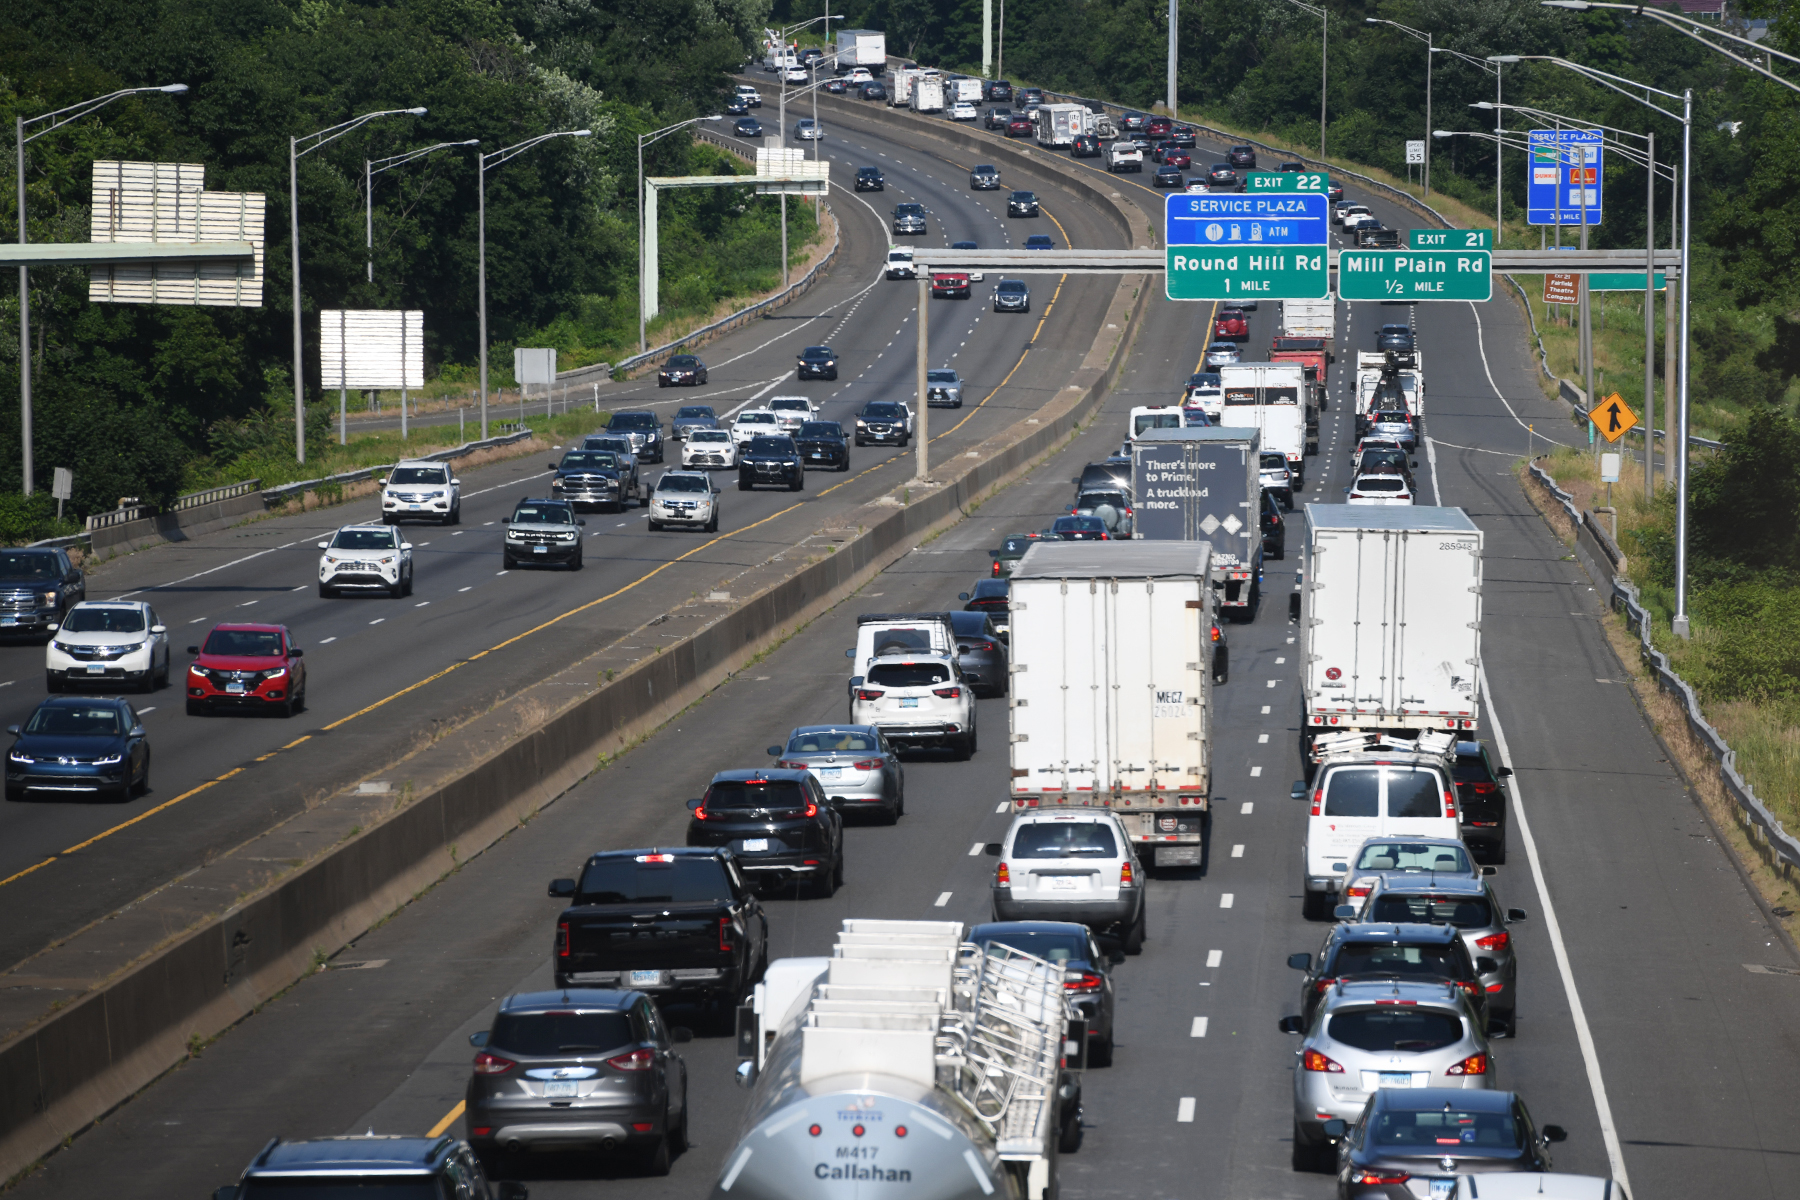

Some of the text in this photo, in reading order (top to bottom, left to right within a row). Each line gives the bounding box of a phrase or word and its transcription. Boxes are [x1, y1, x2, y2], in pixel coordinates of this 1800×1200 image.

[1254, 175, 1322, 190] EXIT 22
[1190, 200, 1307, 212] SERVICE PLAZA
[1269, 226, 1289, 237] ATM
[1417, 232, 1485, 247] EXIT 21
[1174, 255, 1322, 271] Round Hill Rd
[1348, 257, 1483, 272] Mill Plain Rd
[1224, 278, 1271, 293] 1 MILE
[1414, 282, 1445, 292] MILE
[1549, 286, 1574, 294] Theatre
[1546, 294, 1576, 302] Company
[1146, 460, 1216, 470] There's more
[1146, 472, 1196, 482] to Prime.
[1146, 486, 1209, 498] A truckload
[1146, 501, 1179, 509] more.
[836, 1146, 880, 1160] M417
[814, 1163, 912, 1183] Callahan
